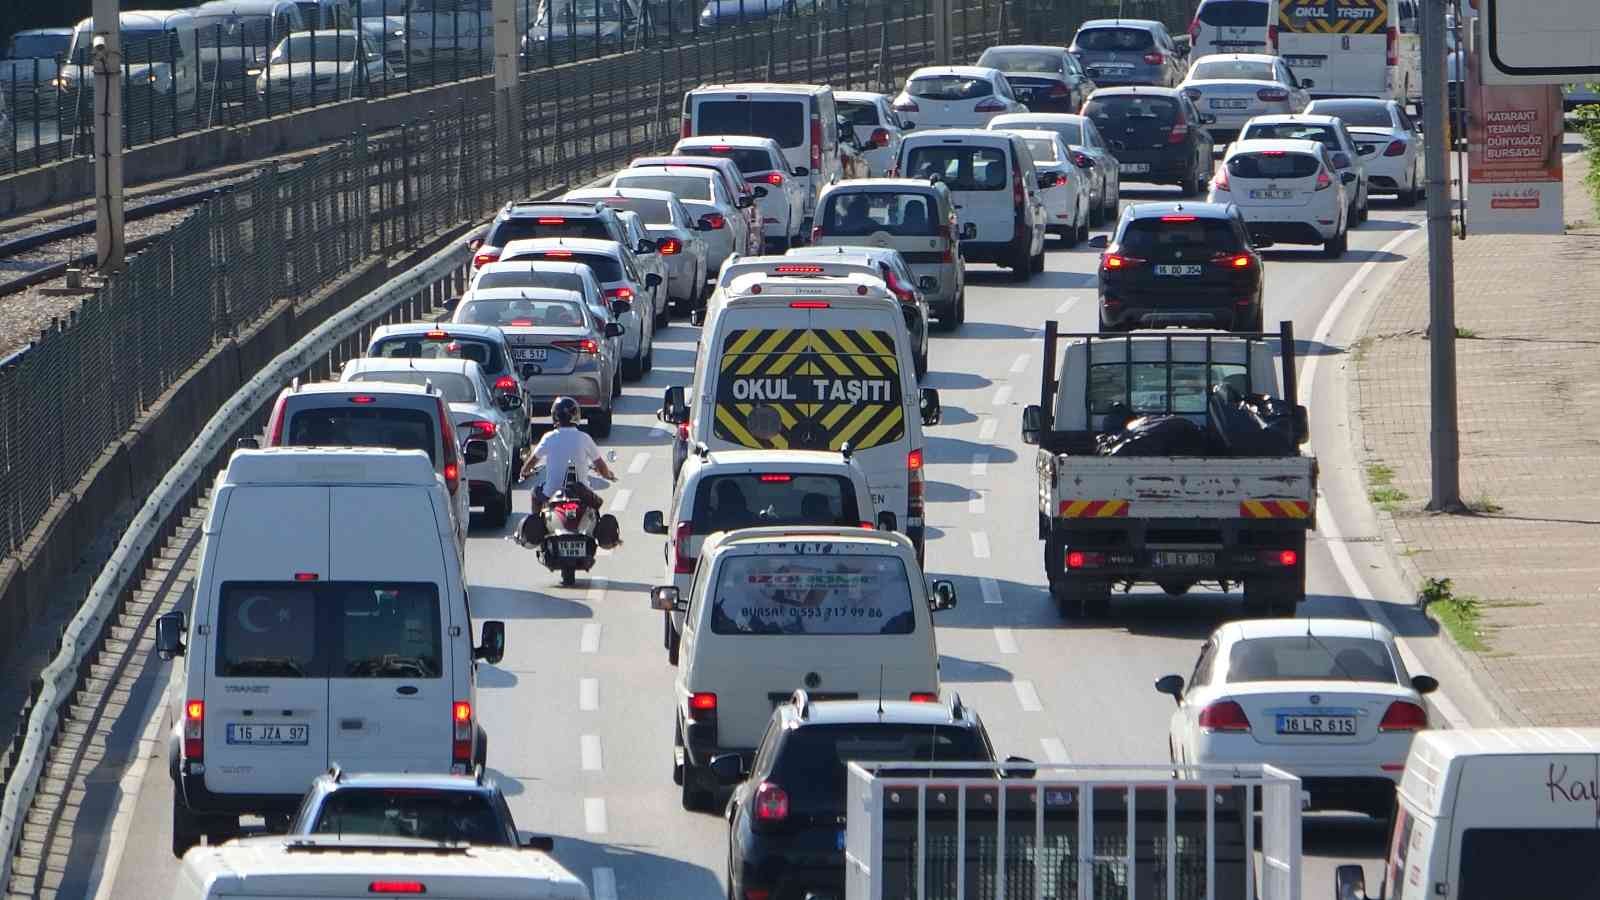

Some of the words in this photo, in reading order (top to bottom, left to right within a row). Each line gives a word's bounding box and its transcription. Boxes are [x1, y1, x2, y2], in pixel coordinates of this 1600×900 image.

[1295, 7, 1328, 17] OKUL
[1487, 111, 1536, 121] KATARAKT
[732, 379, 797, 400] OKUL
[813, 379, 891, 405] TAŞITI
[1286, 719, 1299, 730] 16
[1303, 719, 1322, 731] LR
[1328, 720, 1353, 732] 615
[240, 727, 253, 739] 16
[260, 727, 281, 739] JZA
[289, 727, 304, 739] 97
